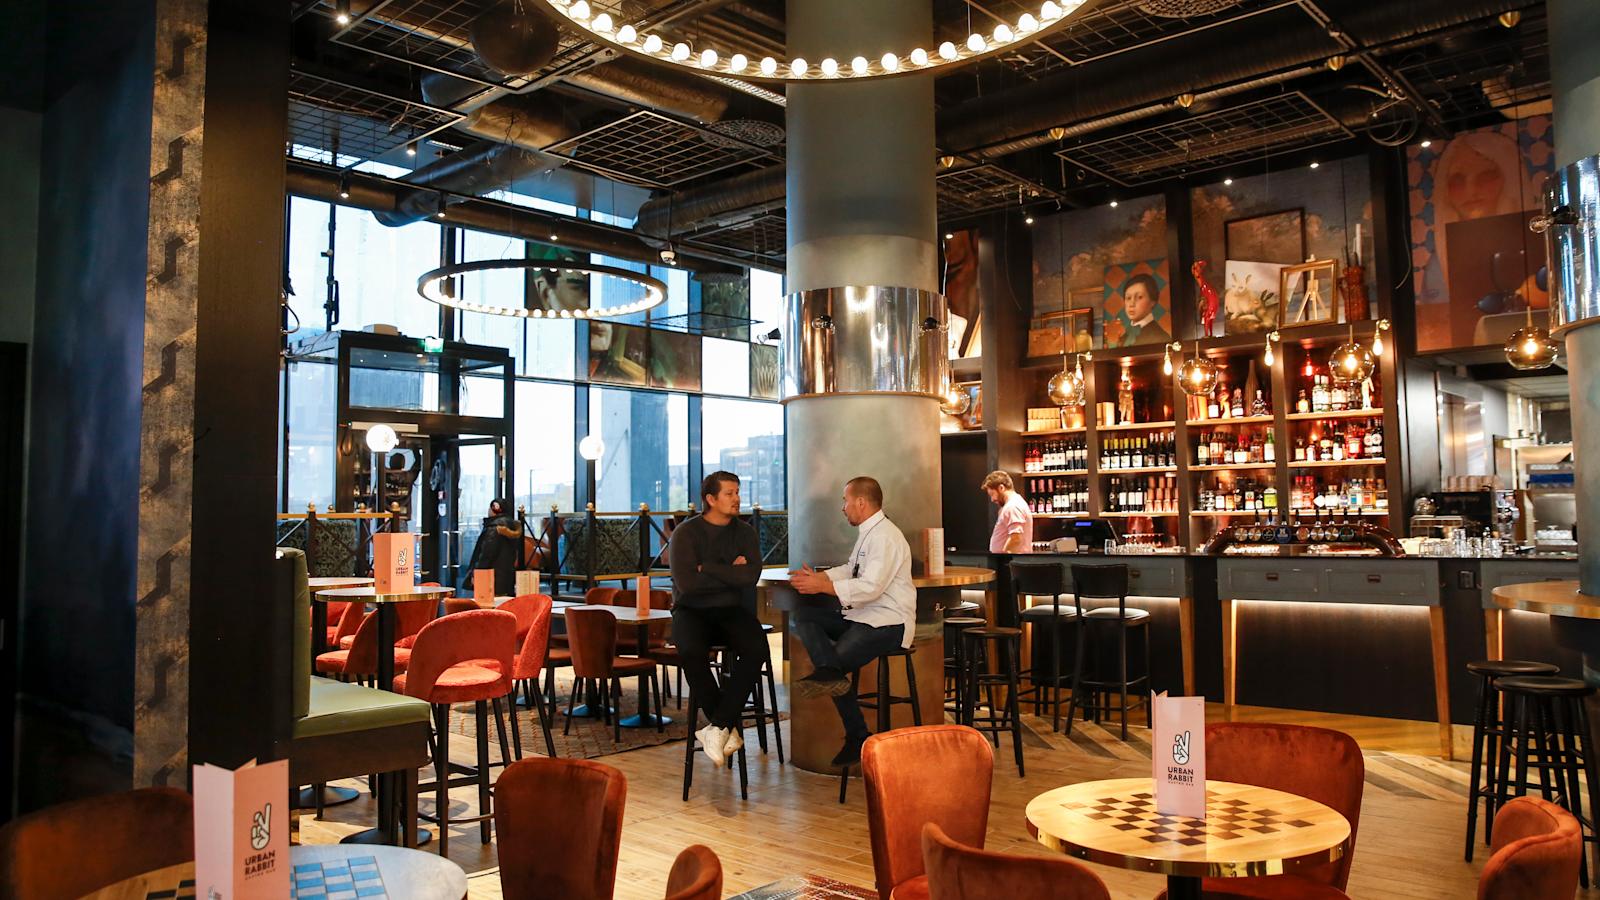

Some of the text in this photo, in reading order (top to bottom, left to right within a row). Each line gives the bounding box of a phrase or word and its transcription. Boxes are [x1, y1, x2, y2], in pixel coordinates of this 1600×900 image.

[1167, 766, 1194, 775] URBAN
[1167, 773, 1193, 782] RABBIT
[245, 849, 275, 866] URBAN
[245, 859, 275, 875] RABBIT
